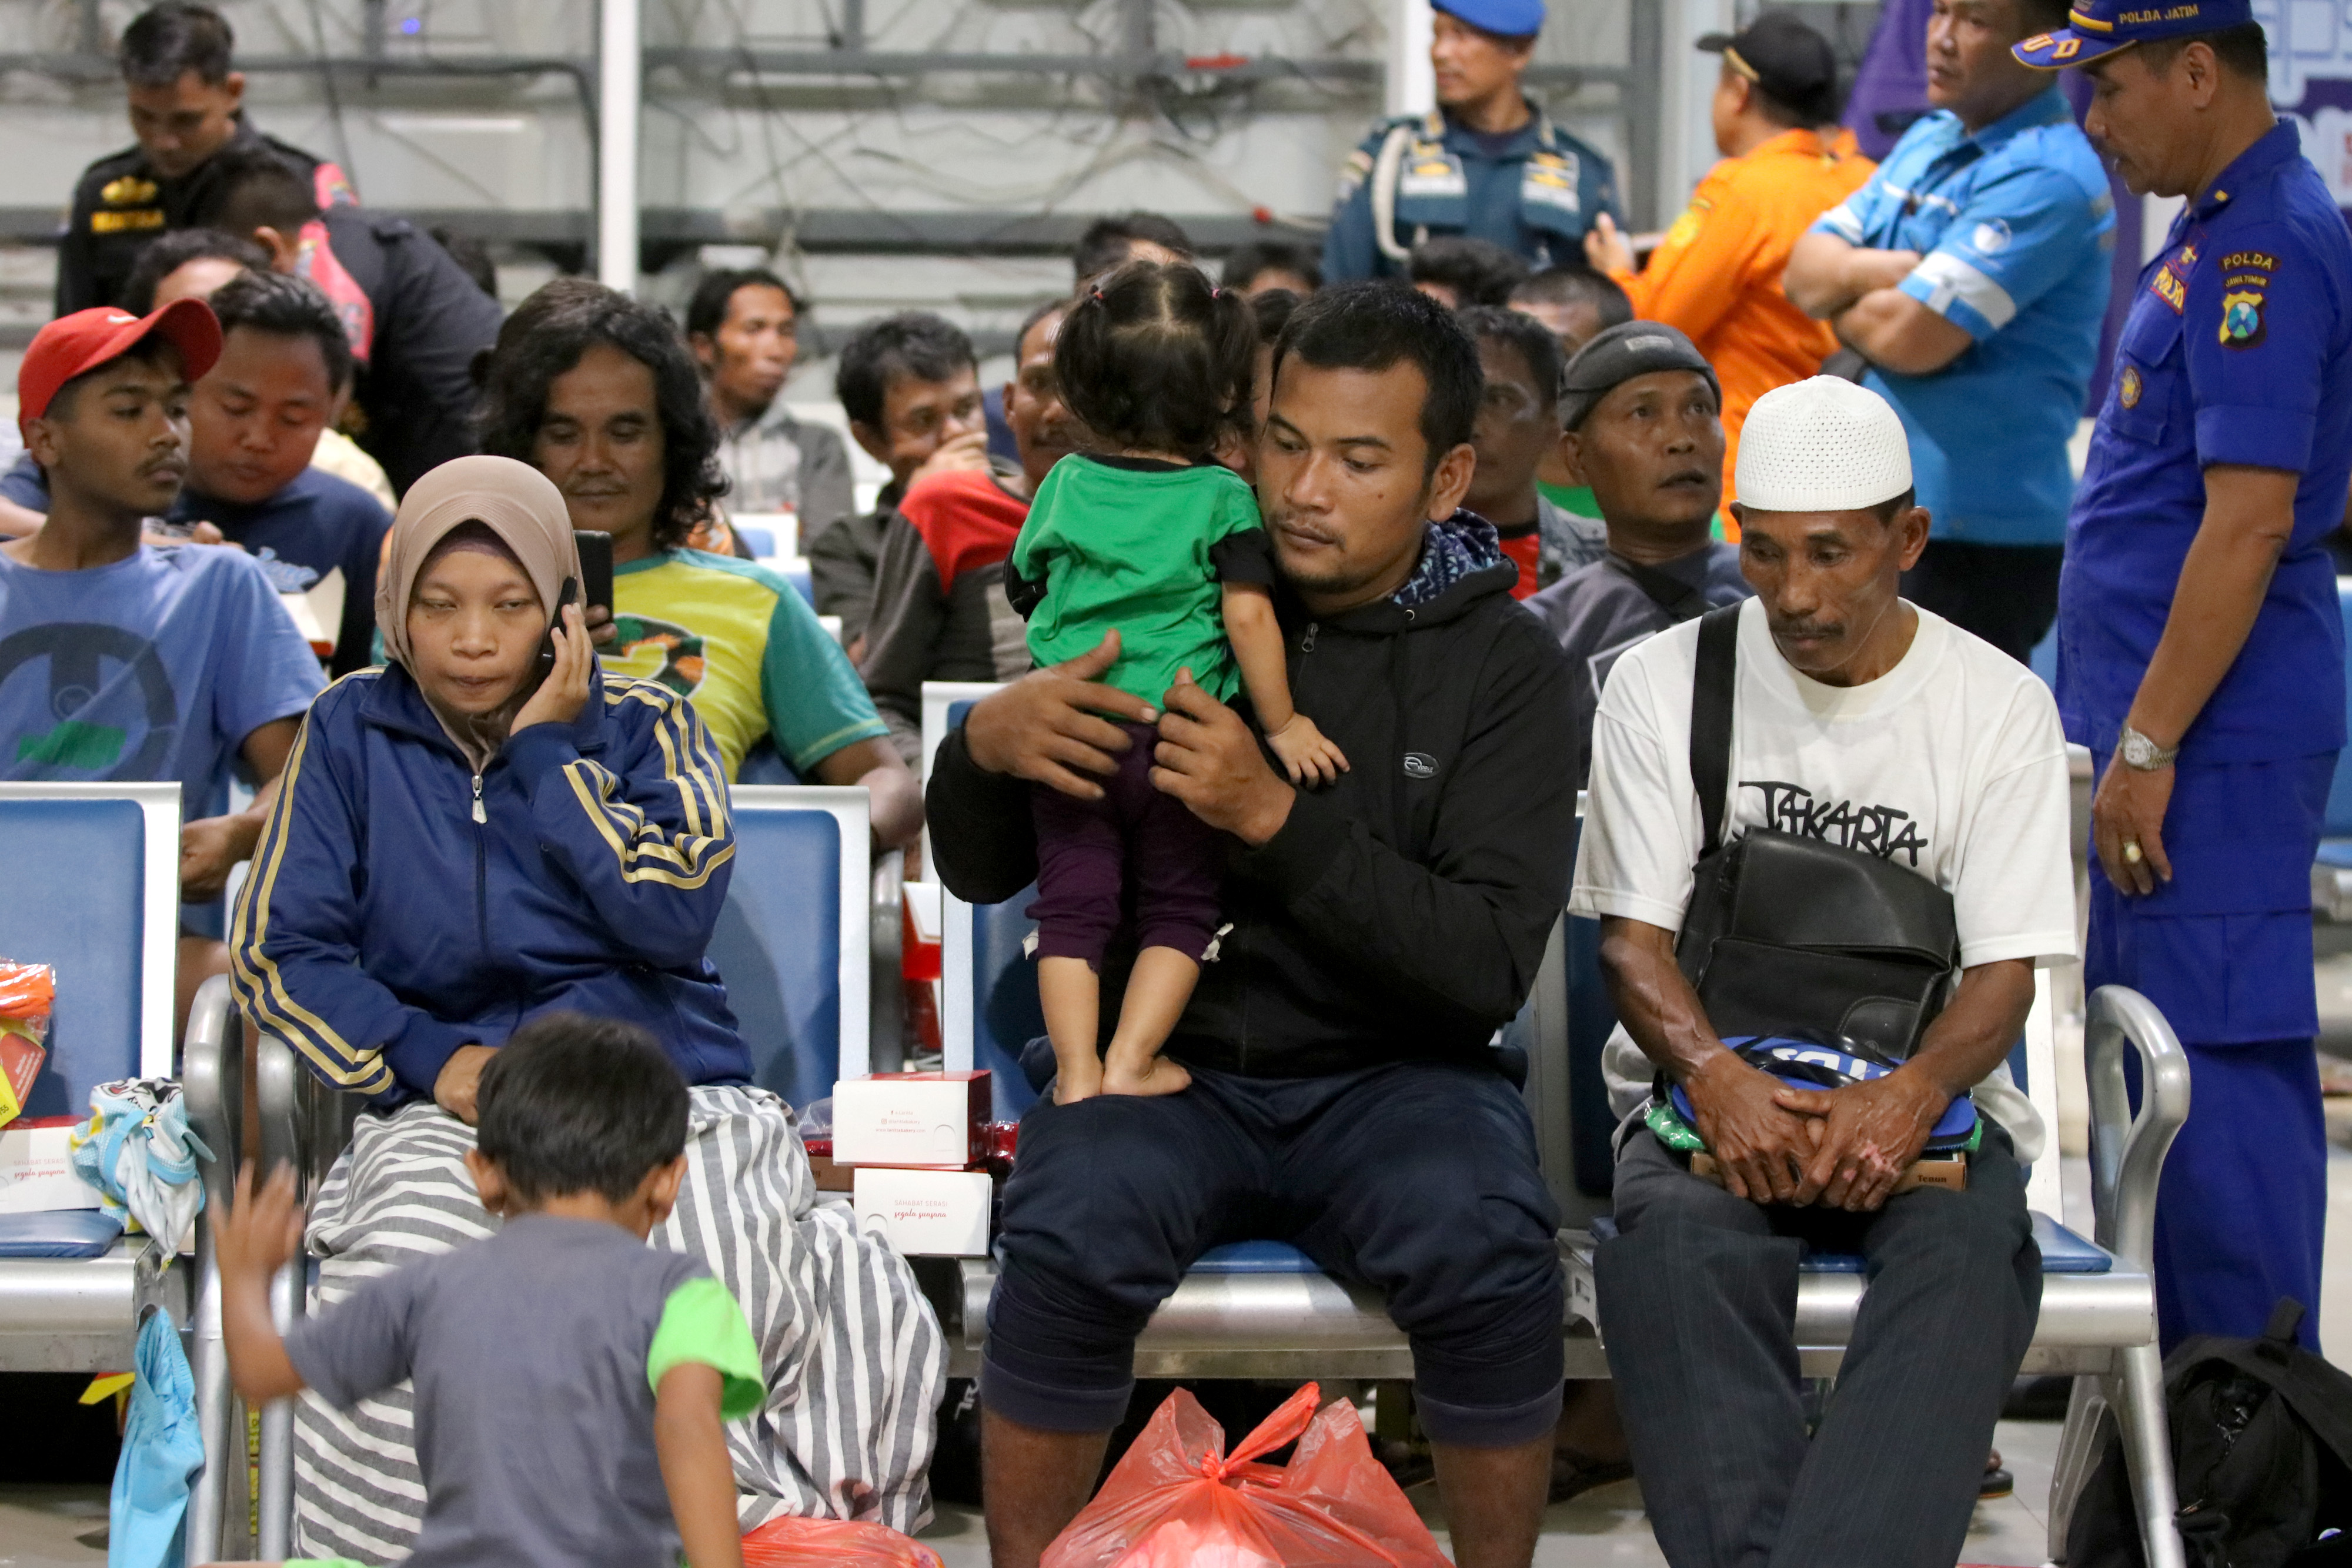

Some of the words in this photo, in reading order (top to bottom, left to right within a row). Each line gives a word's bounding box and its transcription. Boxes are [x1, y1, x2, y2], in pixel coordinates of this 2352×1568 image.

[2119, 9, 2161, 24] POLDA
[2164, 4, 2199, 20] JATIM
[2223, 253, 2273, 270] POLDA
[2226, 275, 2243, 287] JAWA
[2243, 275, 2267, 286] TIMUR
[894, 1208, 917, 1221] segala
[918, 1211, 947, 1219] suasana
